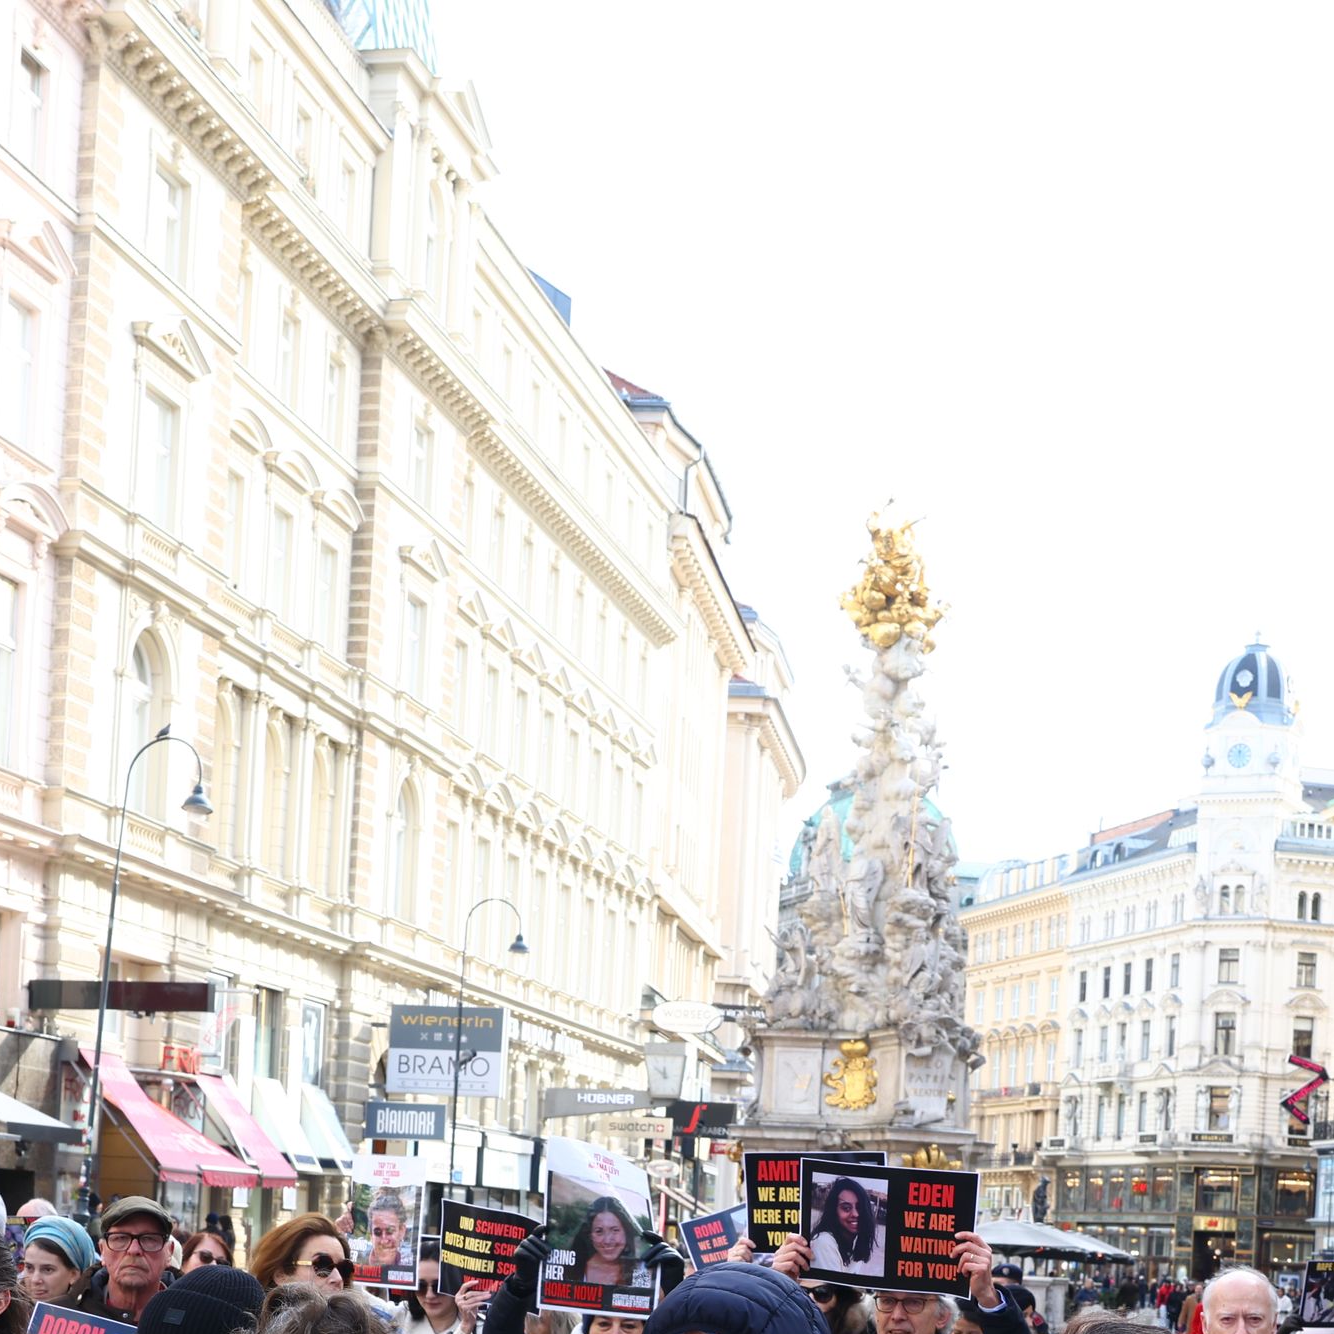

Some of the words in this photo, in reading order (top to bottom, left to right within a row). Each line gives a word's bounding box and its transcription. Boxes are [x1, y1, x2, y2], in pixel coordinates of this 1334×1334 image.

[577, 1092, 635, 1105] HÜBNER
[609, 1121, 655, 1133] swatch
[757, 1160, 799, 1182] AMIT
[757, 1186, 776, 1202] WE
[779, 1186, 800, 1202] ARE
[907, 1181, 955, 1208] EDEN
[753, 1209, 782, 1224] HERE
[904, 1210, 926, 1230] WE
[928, 1212, 956, 1232] ARE
[459, 1215, 475, 1231] UNO
[475, 1218, 526, 1240] SCHWEIGT!
[693, 1221, 724, 1239] ROMI
[444, 1231, 464, 1248] ROTES
[464, 1236, 492, 1254] KREUZ
[698, 1240, 711, 1250] WE
[712, 1236, 729, 1249] ARE
[900, 1235, 957, 1257] WAITING
[546, 1249, 576, 1266] BRING
[1316, 1262, 1333, 1271] RAPE
[545, 1264, 564, 1281] HER
[897, 1260, 924, 1278] FOR
[927, 1263, 957, 1282] YOU!
[544, 1282, 572, 1298] HOME
[573, 1285, 603, 1301] NOW!
